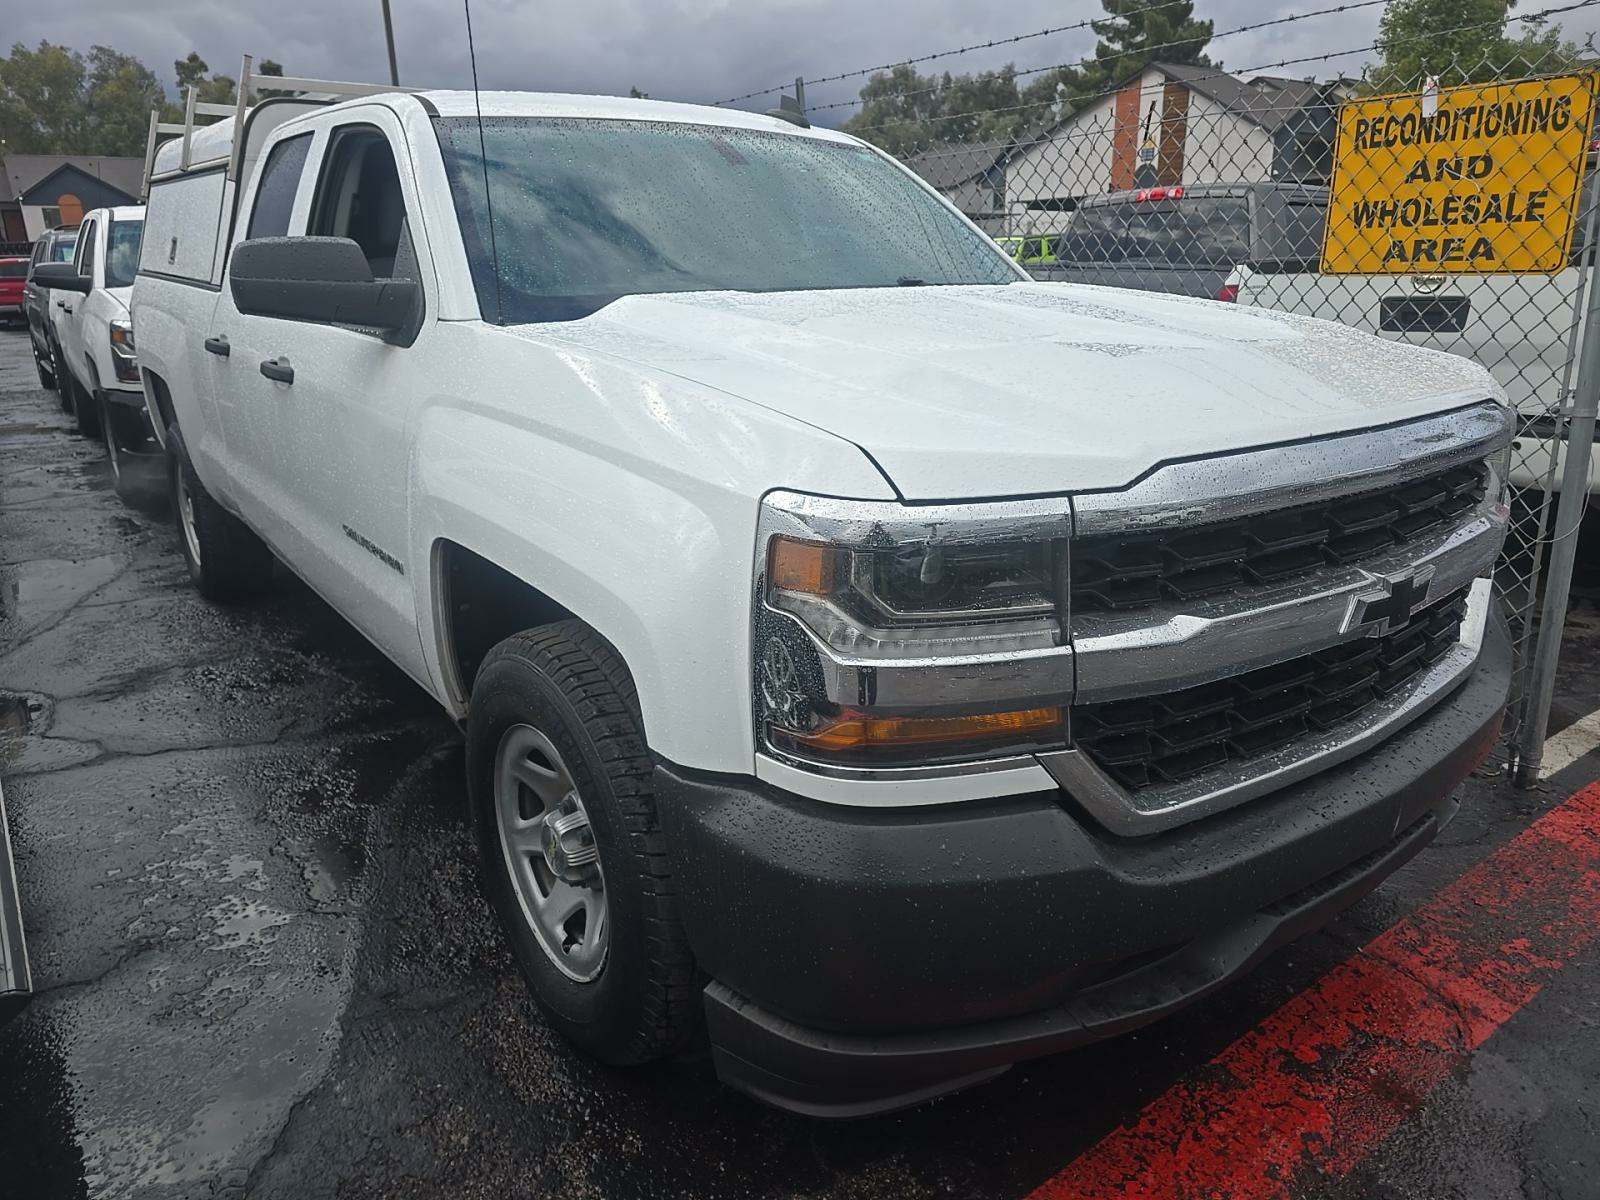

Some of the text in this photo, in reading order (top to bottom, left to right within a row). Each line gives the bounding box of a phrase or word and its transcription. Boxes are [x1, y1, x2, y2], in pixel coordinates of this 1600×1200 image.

[1354, 96, 1571, 149] RECONDITIONING
[1405, 155, 1493, 183] AND
[1353, 191, 1548, 229] WHOLESALE
[1383, 236, 1495, 263] AREA
